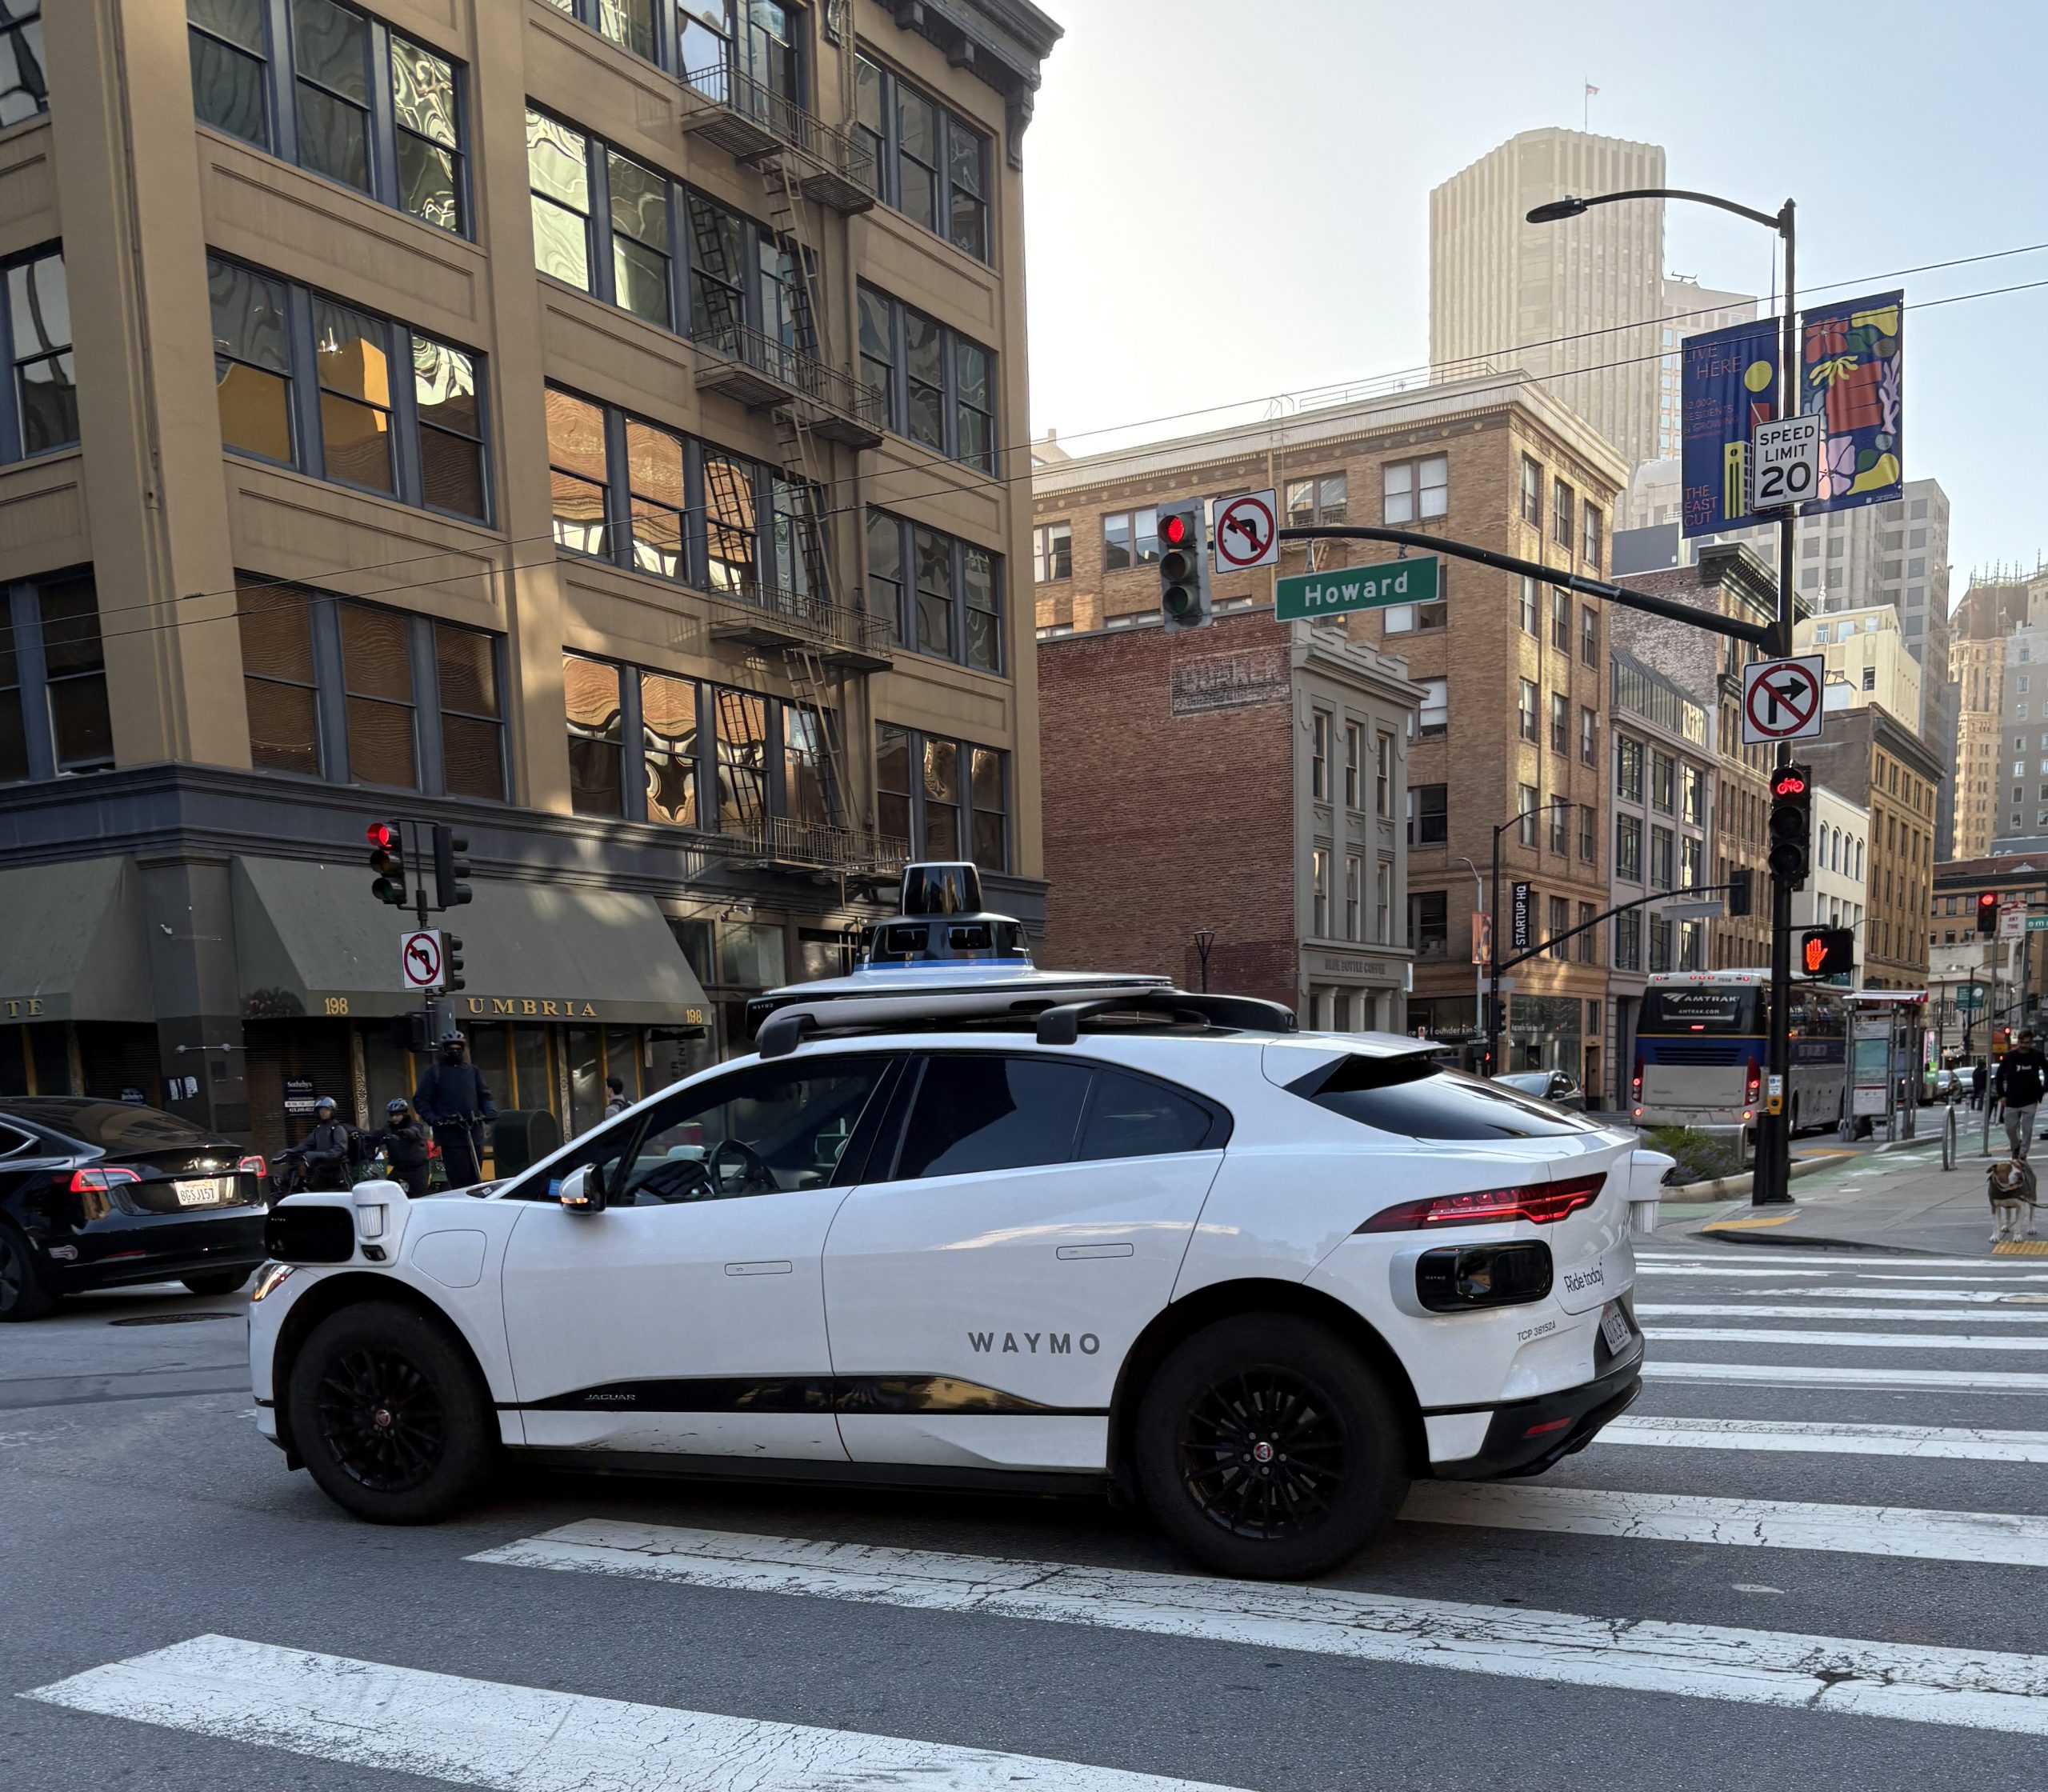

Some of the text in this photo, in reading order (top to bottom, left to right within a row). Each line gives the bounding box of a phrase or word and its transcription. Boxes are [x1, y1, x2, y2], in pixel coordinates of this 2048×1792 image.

[1682, 342, 1718, 362] LIVE
[1697, 356, 1742, 379] HERE
[1760, 426, 1814, 446] SPEED
[1765, 443, 1808, 462] LIMIT
[1760, 462, 1811, 498] 20
[1684, 484, 1710, 500] THE
[1684, 496, 1718, 514] EAST
[1684, 511, 1712, 528] CUT
[1305, 570, 1408, 607] Howard
[1515, 884, 1526, 946] STARTUP HQ
[325, 997, 349, 1014] 198
[467, 998, 598, 1017] UMBRIA
[686, 1008, 703, 1023] 198
[1563, 1266, 1605, 1294] Ride today
[967, 1332, 1101, 1354] WAYMO
[1517, 1329, 1533, 1342] TCP
